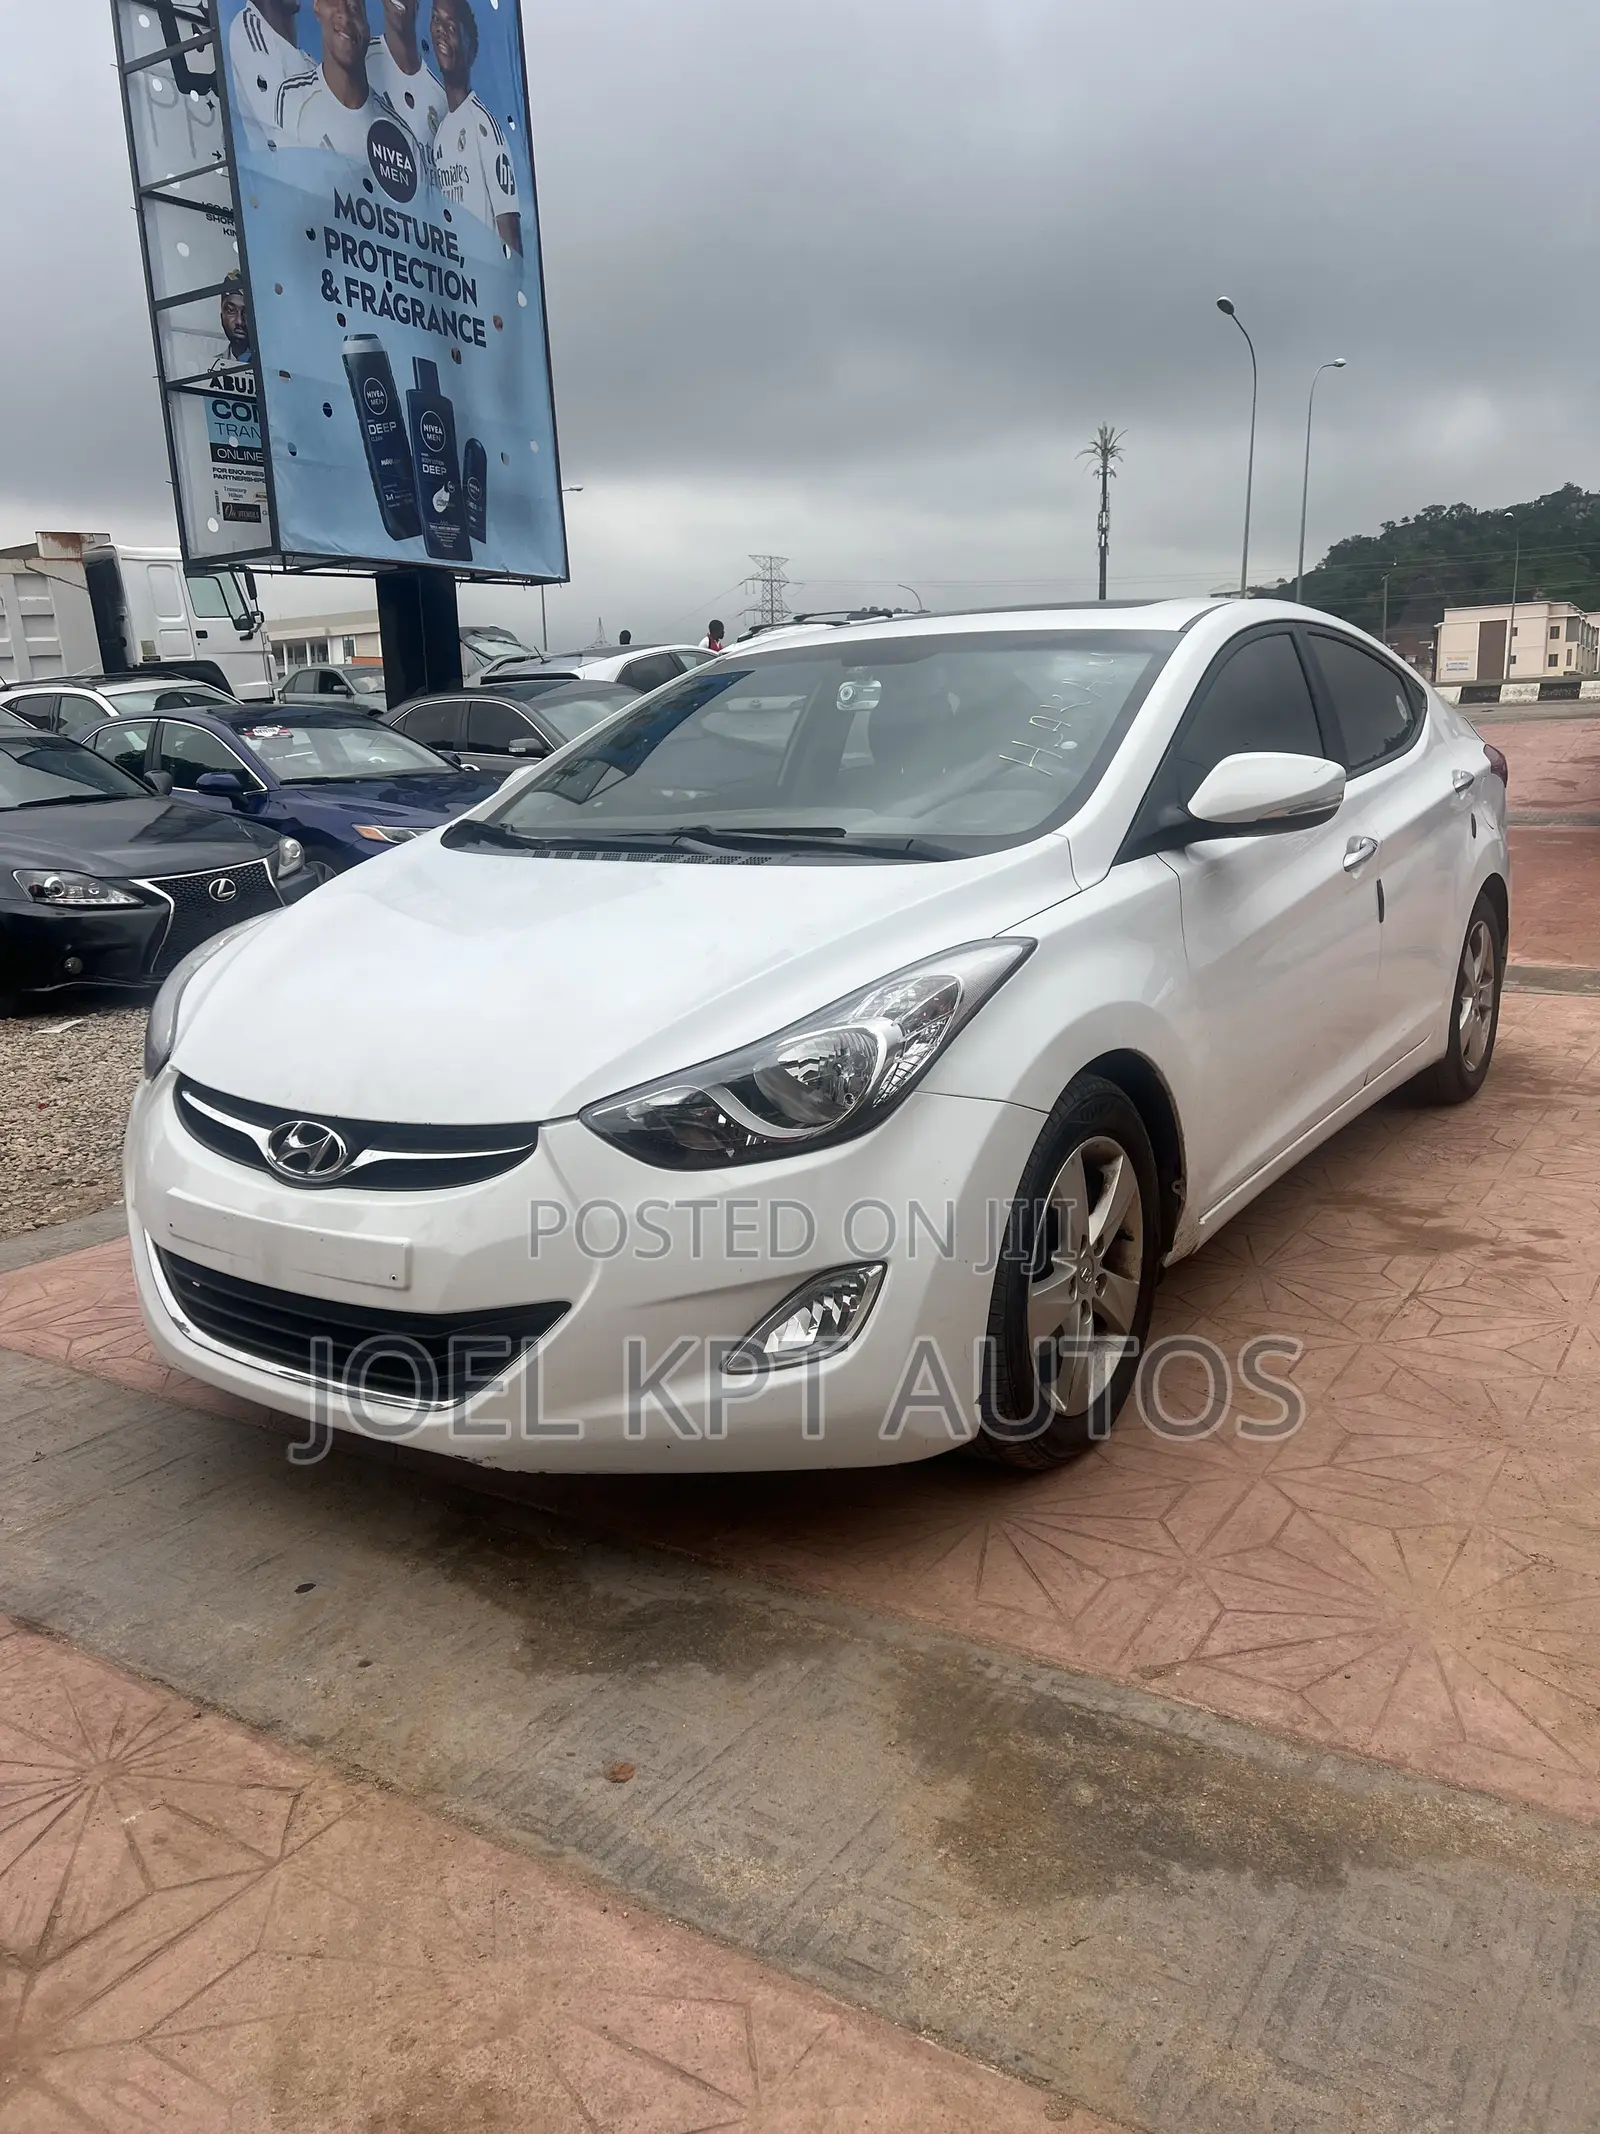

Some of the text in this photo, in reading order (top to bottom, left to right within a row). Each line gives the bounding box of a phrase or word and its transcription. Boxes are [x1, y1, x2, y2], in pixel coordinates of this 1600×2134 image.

[371, 141, 413, 173] NIVEA
[379, 163, 410, 186] MEN
[205, 213, 237, 226] SHOR
[333, 187, 465, 269] MOISTURE,
[323, 226, 478, 308] PROTECTION
[321, 268, 487, 348] & FRAGRANCE
[366, 390, 385, 399] NIVEA
[368, 421, 397, 435] DEEP
[423, 423, 443, 435] NIVEA
[426, 433, 441, 442] MEN
[216, 447, 264, 463] ONLINE
[212, 466, 228, 474] FOR
[422, 463, 447, 476] DEEP
